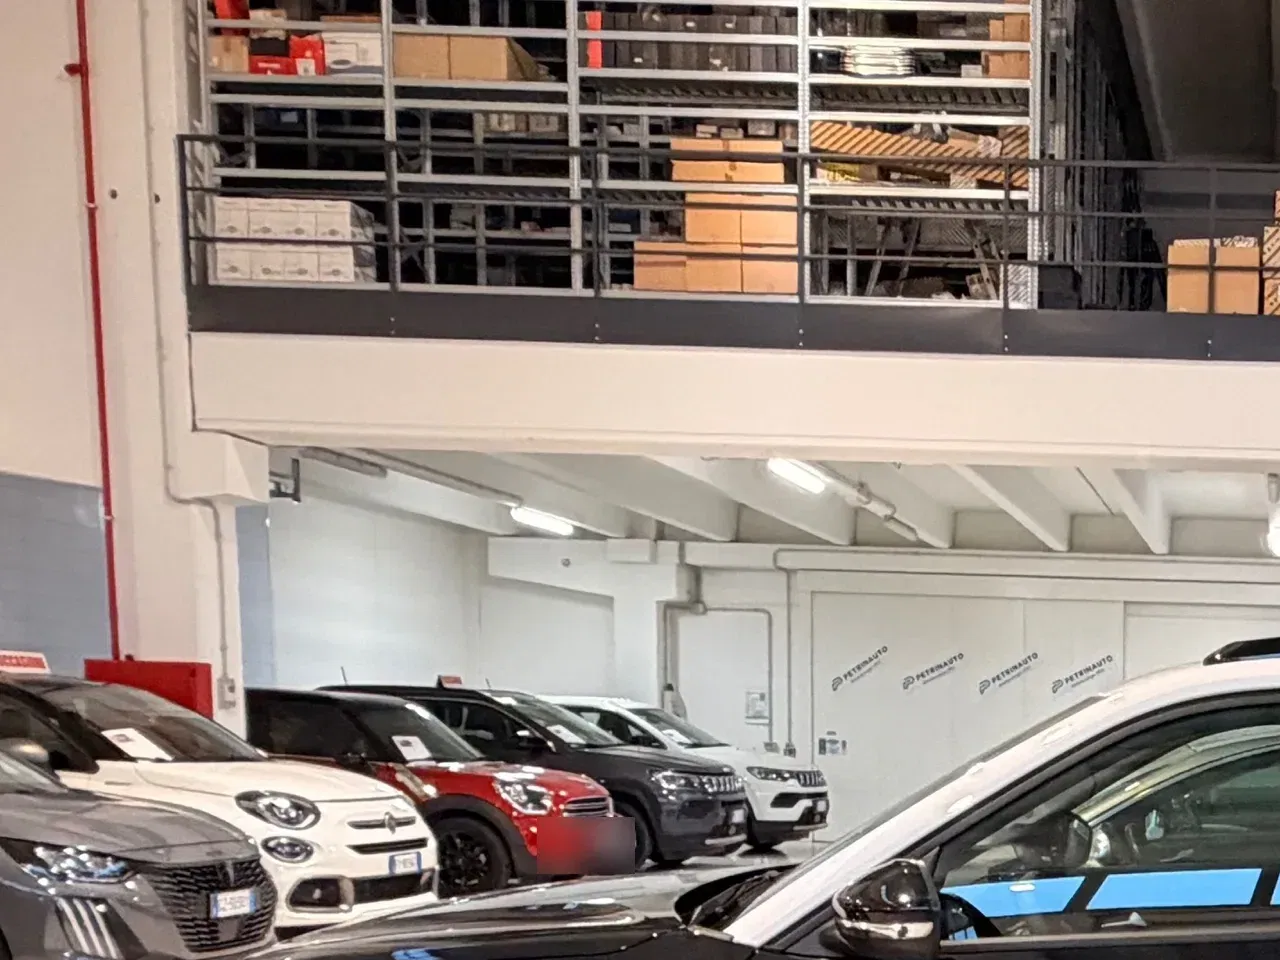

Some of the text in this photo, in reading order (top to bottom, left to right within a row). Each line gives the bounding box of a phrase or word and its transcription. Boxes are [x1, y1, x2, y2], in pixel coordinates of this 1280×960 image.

[843, 645, 888, 680] PETRINAUTO
[915, 652, 964, 681] PETRINAUTO
[991, 652, 1039, 684] PETRINAUTO
[1064, 654, 1113, 684] PETRINAUTO
